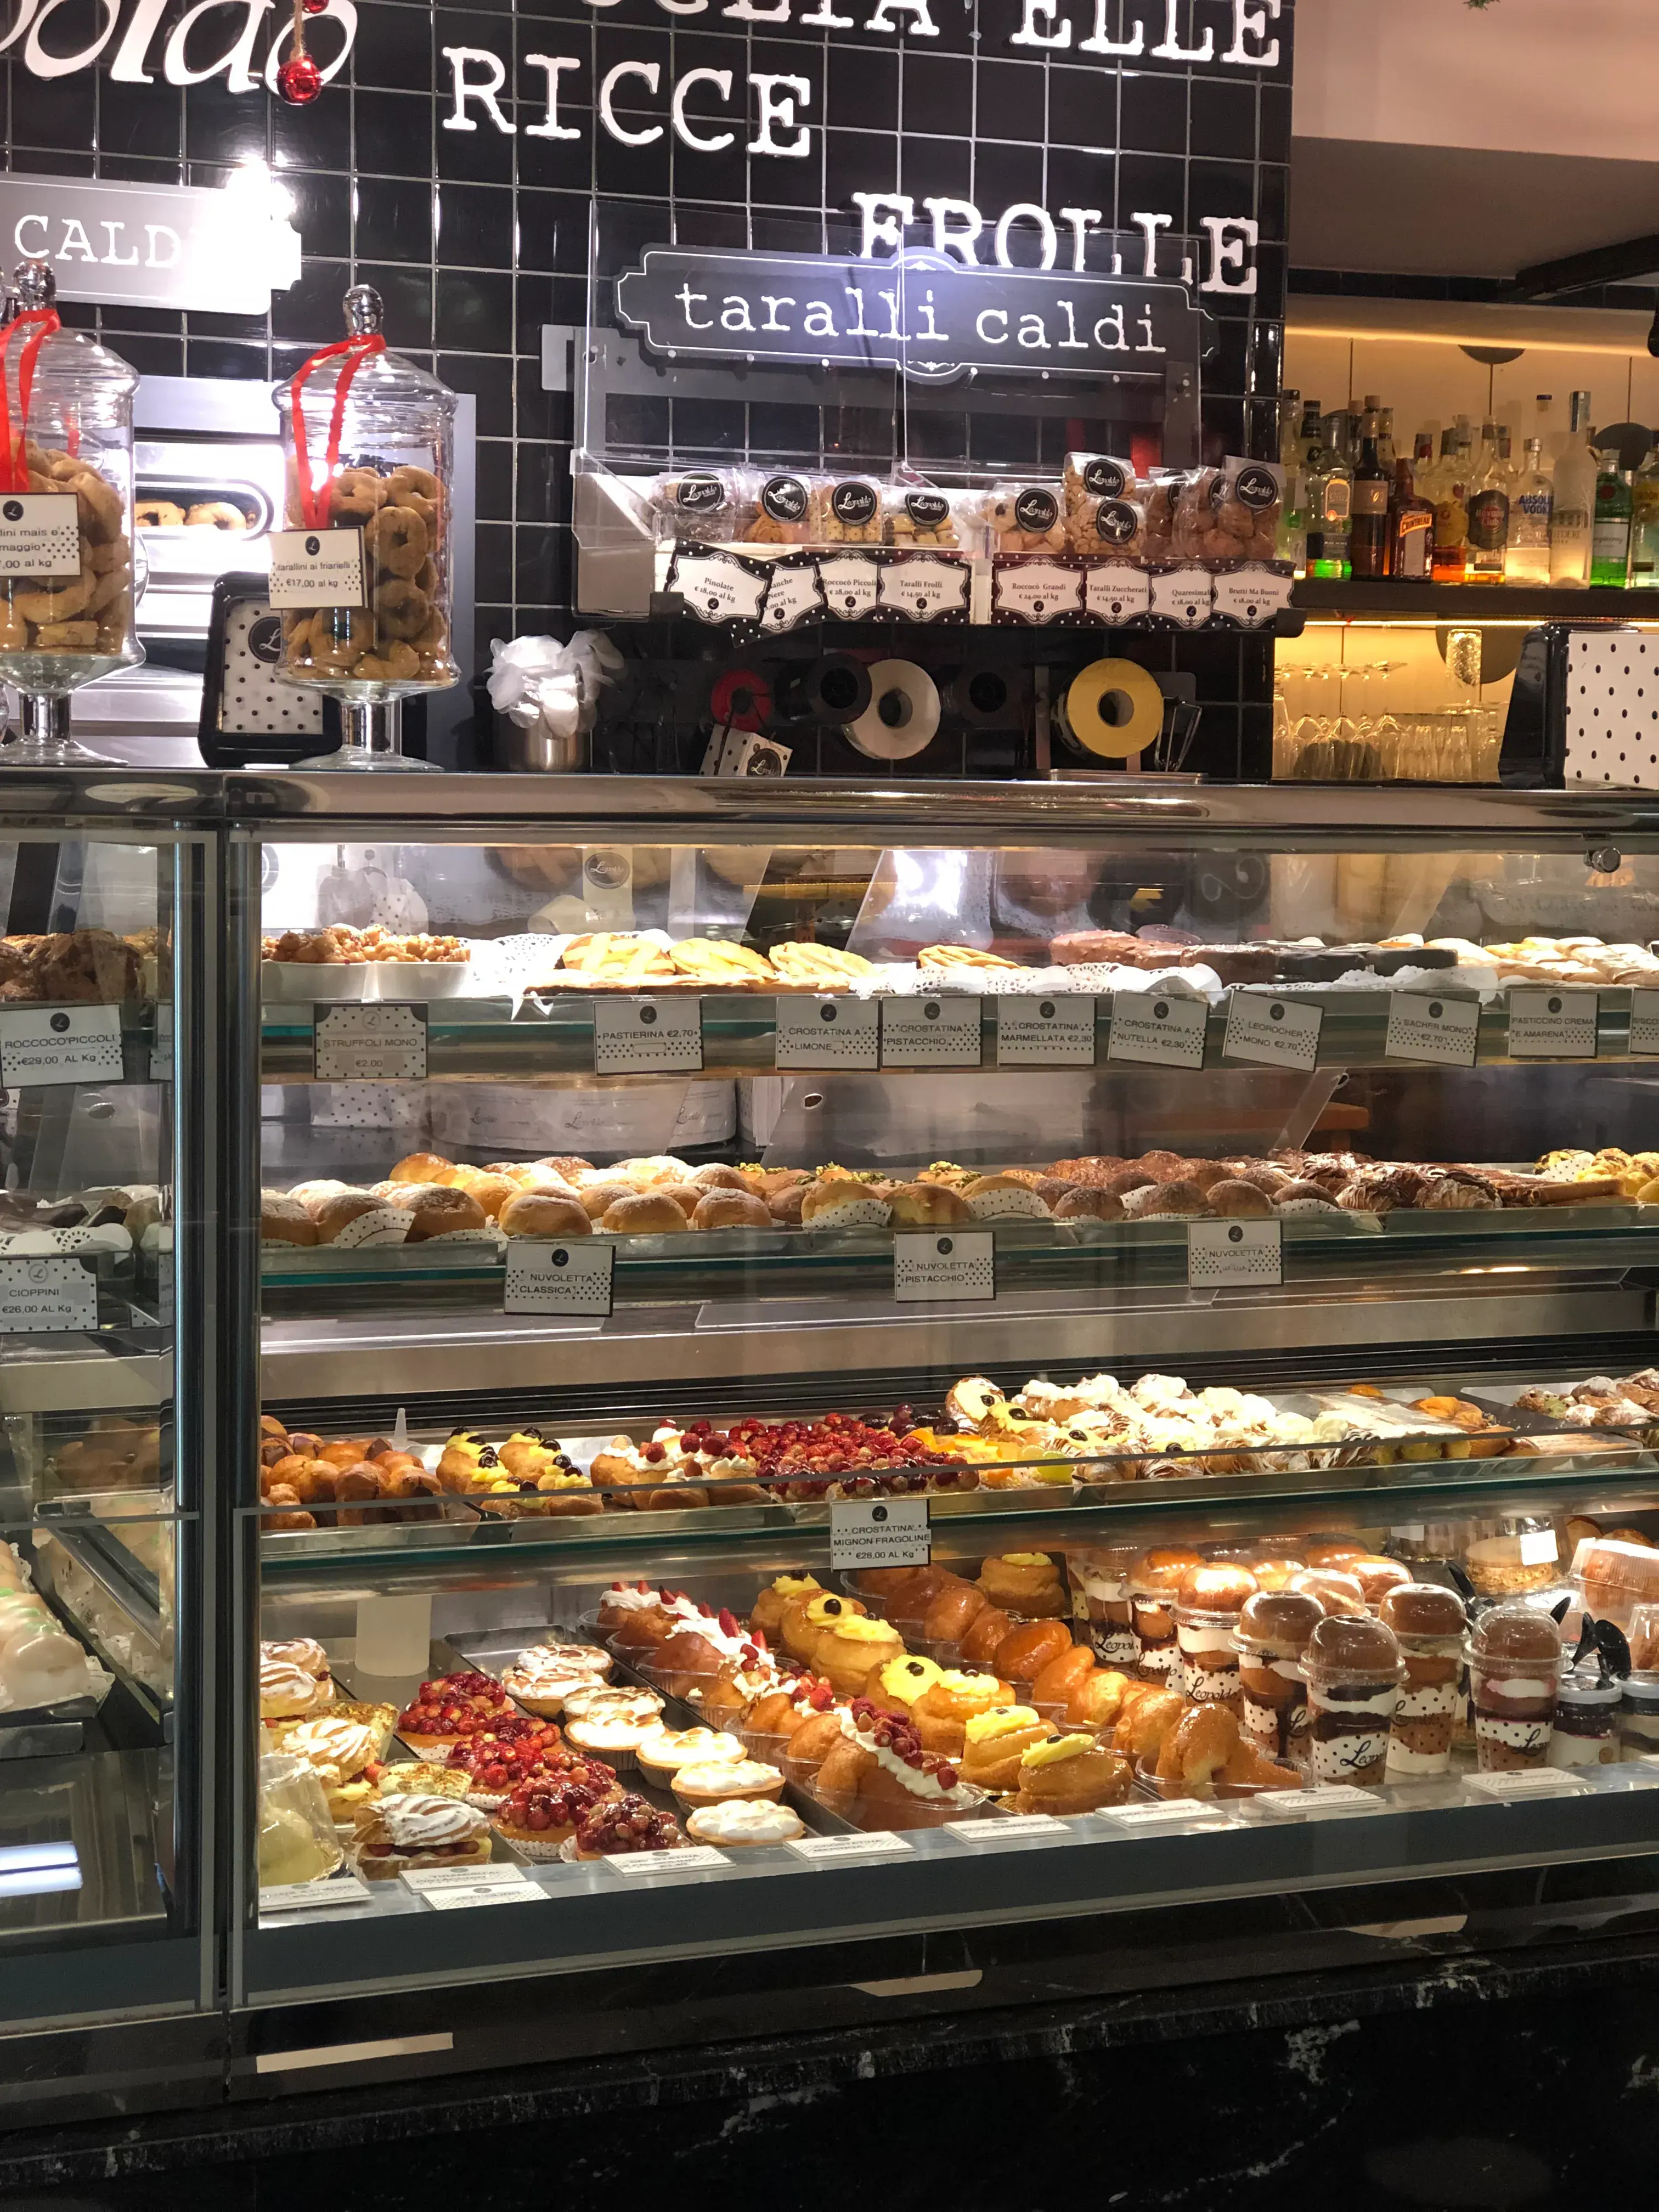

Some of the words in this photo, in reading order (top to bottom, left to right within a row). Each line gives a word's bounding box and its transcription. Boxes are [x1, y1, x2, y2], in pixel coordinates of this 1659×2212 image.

[442, 46, 811, 157] RICCE
[14, 215, 189, 269] CALD
[852, 192, 1259, 294] FROLLE
[675, 283, 949, 341] taralli
[976, 301, 1166, 353] caldi
[838, 492, 871, 510] Leopoldo
[911, 496, 944, 510] Leopoldo
[20, 527, 47, 536] mais
[0, 560, 20, 569] ,00
[39, 559, 52, 568] kg
[278, 562, 307, 571] tarallini
[320, 561, 351, 570] friarielli
[286, 578, 315, 588] €17,00
[329, 579, 338, 588] kg
[704, 577, 734, 591] Pinolate
[770, 578, 793, 589] anche
[924, 580, 943, 589] Frolli
[863, 589, 871, 597] kg
[1112, 585, 1147, 594] Zuccherati
[727, 594, 736, 603] kg
[1050, 592, 1059, 601] kg
[1262, 597, 1271, 606] kg
[1201, 599, 1210, 607] kg
[1018, 1022, 1079, 1030] CROSTATINA
[1124, 1019, 1182, 1033] CROSTATINA
[1512, 1017, 1562, 1025] PASTICCINO
[1248, 1021, 1304, 1038] LEOROCHER
[1403, 1019, 1440, 1029] SACHER
[1441, 1024, 1469, 1034] MONO
[603, 1030, 664, 1040] PASTIERINA
[667, 1029, 693, 1038] €2,70
[788, 1028, 851, 1036] CROSTATINA
[1001, 1034, 1065, 1042] MARMELLATA
[1117, 1032, 1158, 1043] NUTELLA
[1243, 1036, 1271, 1047] MONO
[324, 1039, 381, 1047] STRUFFOLI
[21, 1056, 59, 1065] €29,00
[64, 1054, 78, 1063] AL
[82, 1054, 96, 1063] Kg
[1209, 1249, 1263, 1258] NUVOLETTA
[917, 1262, 975, 1271] NUVOLETTA
[531, 1273, 592, 1283] NUVOLETTA
[905, 1274, 965, 1283] PISTACCHIO
[9, 1289, 59, 1297] CIOPPINI
[520, 1285, 571, 1294] CLASSICA
[2, 1305, 37, 1314] €26,00
[58, 1305, 71, 1313] Kg
[851, 1525, 913, 1534] CROSTATINA
[833, 1537, 873, 1546] MIGNON
[875, 1534, 931, 1544] FRAGOLINE
[1137, 1652, 1178, 1677] Leopoldo
[1186, 1675, 1238, 1703] Leopoldo
